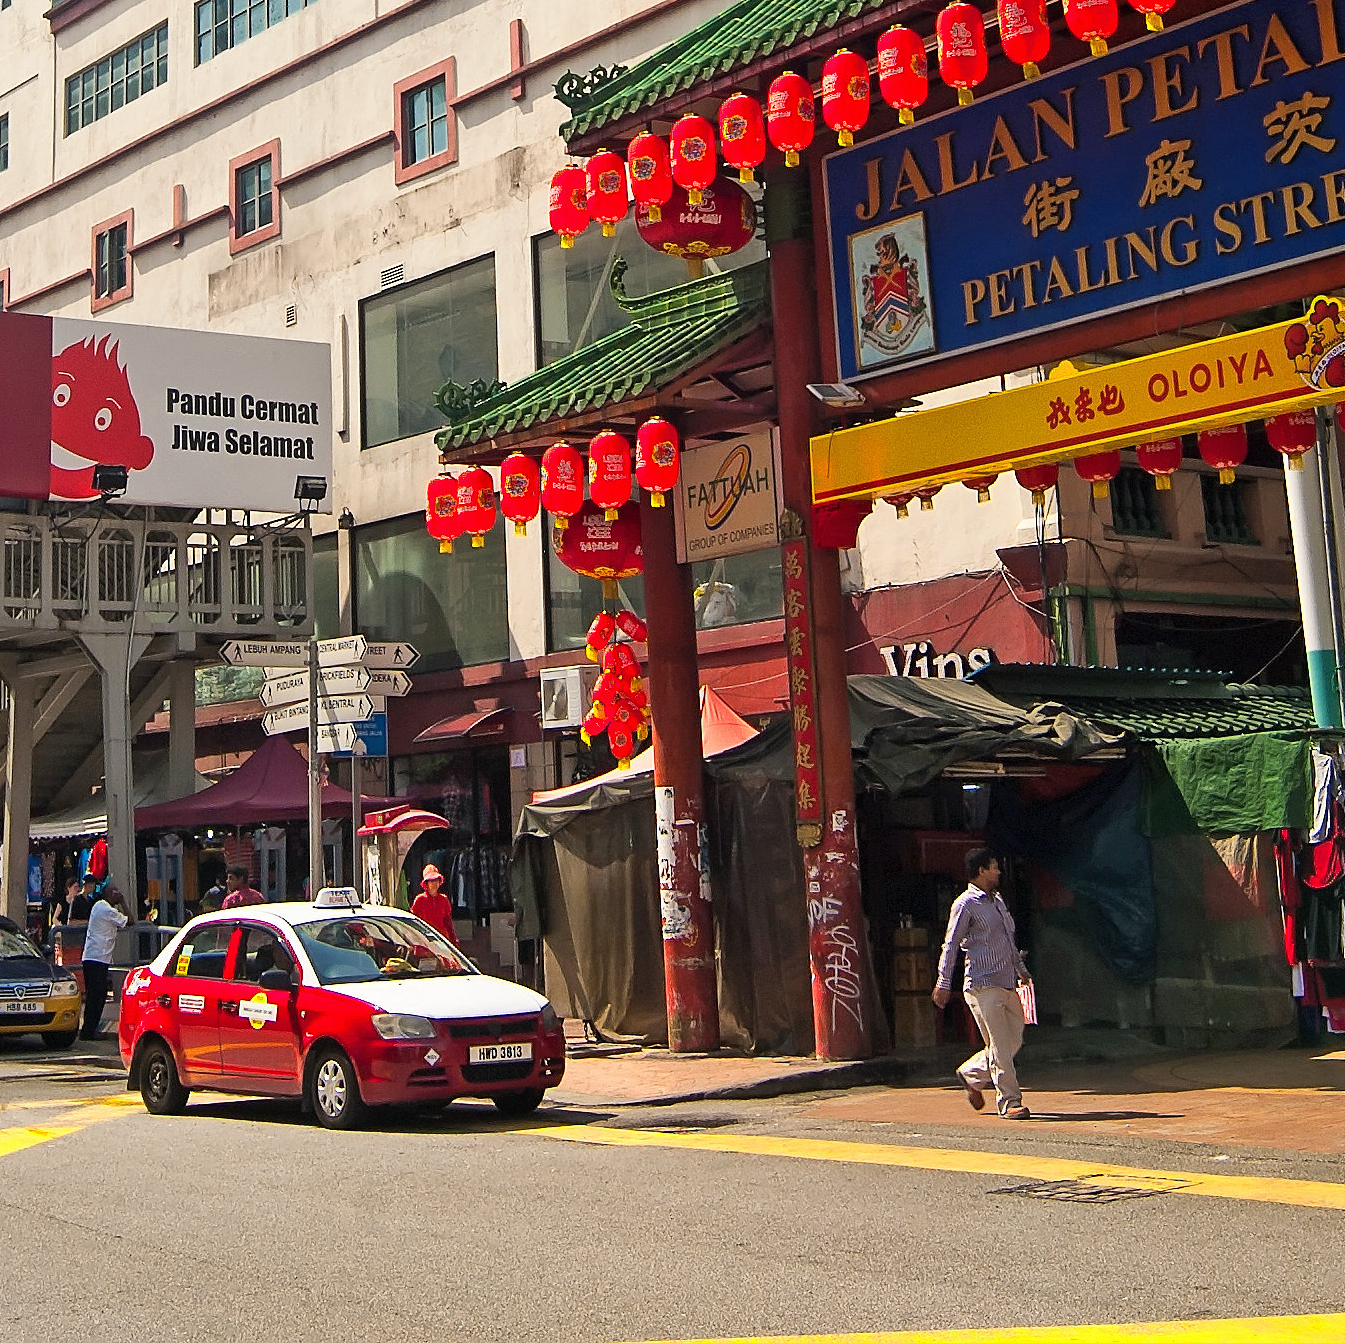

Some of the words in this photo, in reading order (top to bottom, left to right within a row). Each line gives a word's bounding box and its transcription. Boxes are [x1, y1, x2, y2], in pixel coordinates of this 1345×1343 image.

[855, 87, 1079, 222] JALAN
[963, 217, 1201, 325] PETALING
[1147, 348, 1275, 403] OLOIYA
[166, 387, 236, 420] Pandu
[240, 392, 320, 426] Cermat
[172, 424, 221, 453] Jiwa
[225, 428, 315, 461] Selamat
[687, 468, 770, 508] FATTUAH
[689, 535, 717, 552] GROUP
[717, 533, 729, 545] OF
[729, 522, 775, 544] COMPANIES
[243, 644, 268, 655] LEBUH
[269, 645, 302, 655] AMPANG
[276, 677, 304, 692] PUDURAYA
[320, 669, 355, 681] BRICKFIELDS
[288, 705, 309, 718] BINTANG
[479, 1047, 498, 1060] HWD
